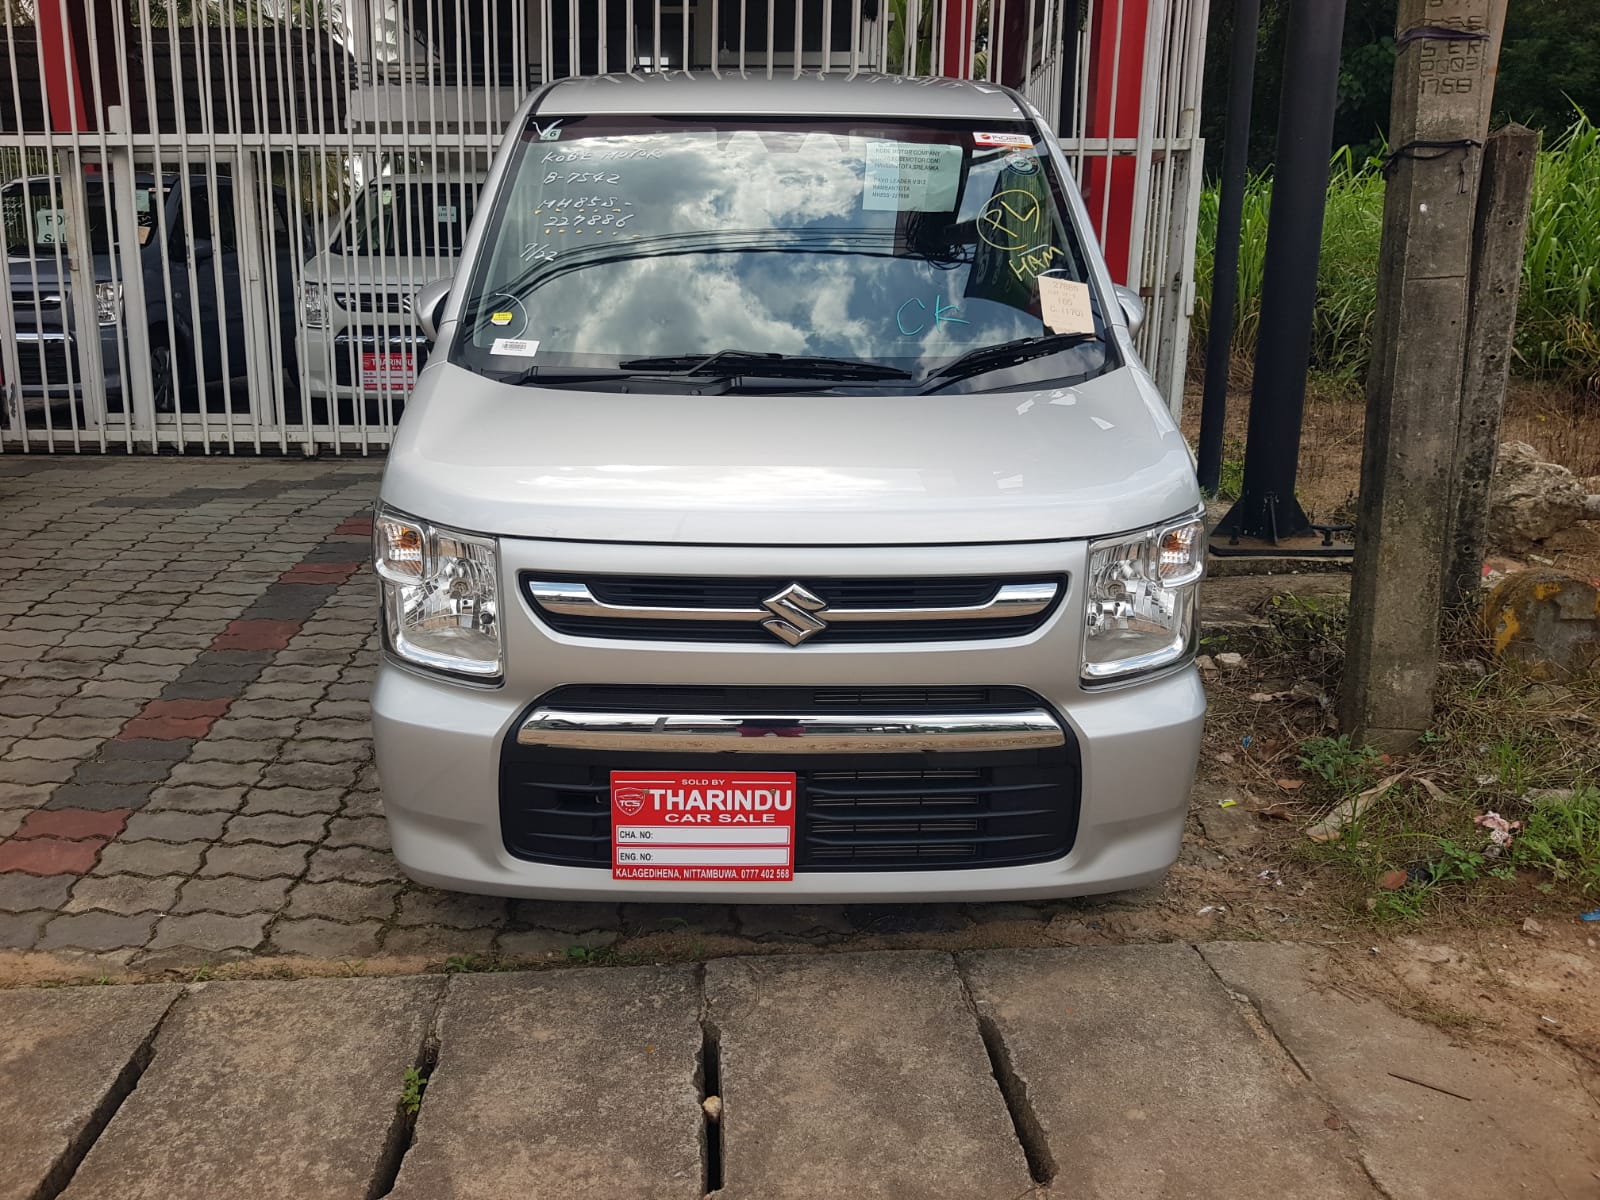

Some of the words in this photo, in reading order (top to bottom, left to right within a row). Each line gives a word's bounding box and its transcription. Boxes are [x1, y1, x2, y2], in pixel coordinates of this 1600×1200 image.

[541, 151, 593, 164] KOBE
[543, 171, 621, 185] B-7542
[544, 214, 635, 228] 227886
[1008, 246, 1065, 281] HAM
[649, 789, 792, 811] THARINDU
[664, 814, 712, 823] CAR
[718, 814, 776, 823] SALE
[619, 831, 637, 839] CHA.
[639, 831, 654, 839] NO:
[620, 853, 638, 861] ENG.
[640, 853, 654, 861] NO:
[615, 868, 682, 879] KALAGEDIHENA,
[741, 869, 759, 879] 0777
[760, 869, 775, 879] 402
